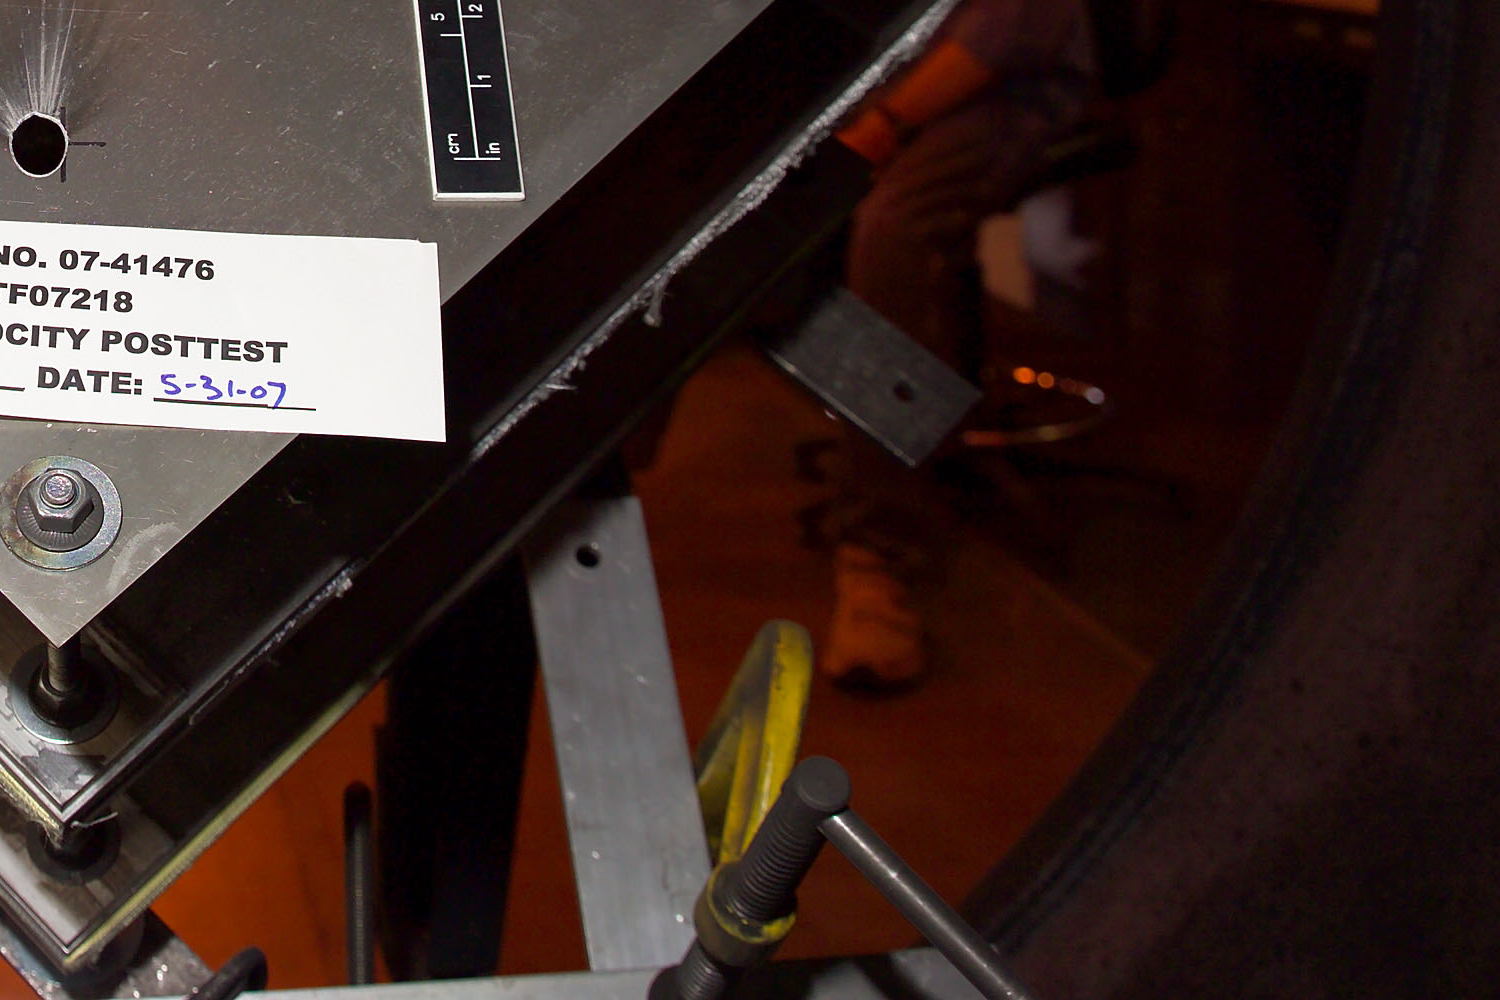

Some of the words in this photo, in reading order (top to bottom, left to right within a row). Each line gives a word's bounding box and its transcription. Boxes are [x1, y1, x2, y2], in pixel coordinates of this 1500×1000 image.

[431, 12, 445, 22] 5
[469, 3, 483, 13] 2
[447, 133, 460, 154] cm
[486, 142, 501, 154] in
[60, 250, 214, 280] 07-41476
[102, 330, 288, 363] POSTTEST
[38, 366, 142, 395] DATE:
[161, 373, 287, 410] 5-31-07
